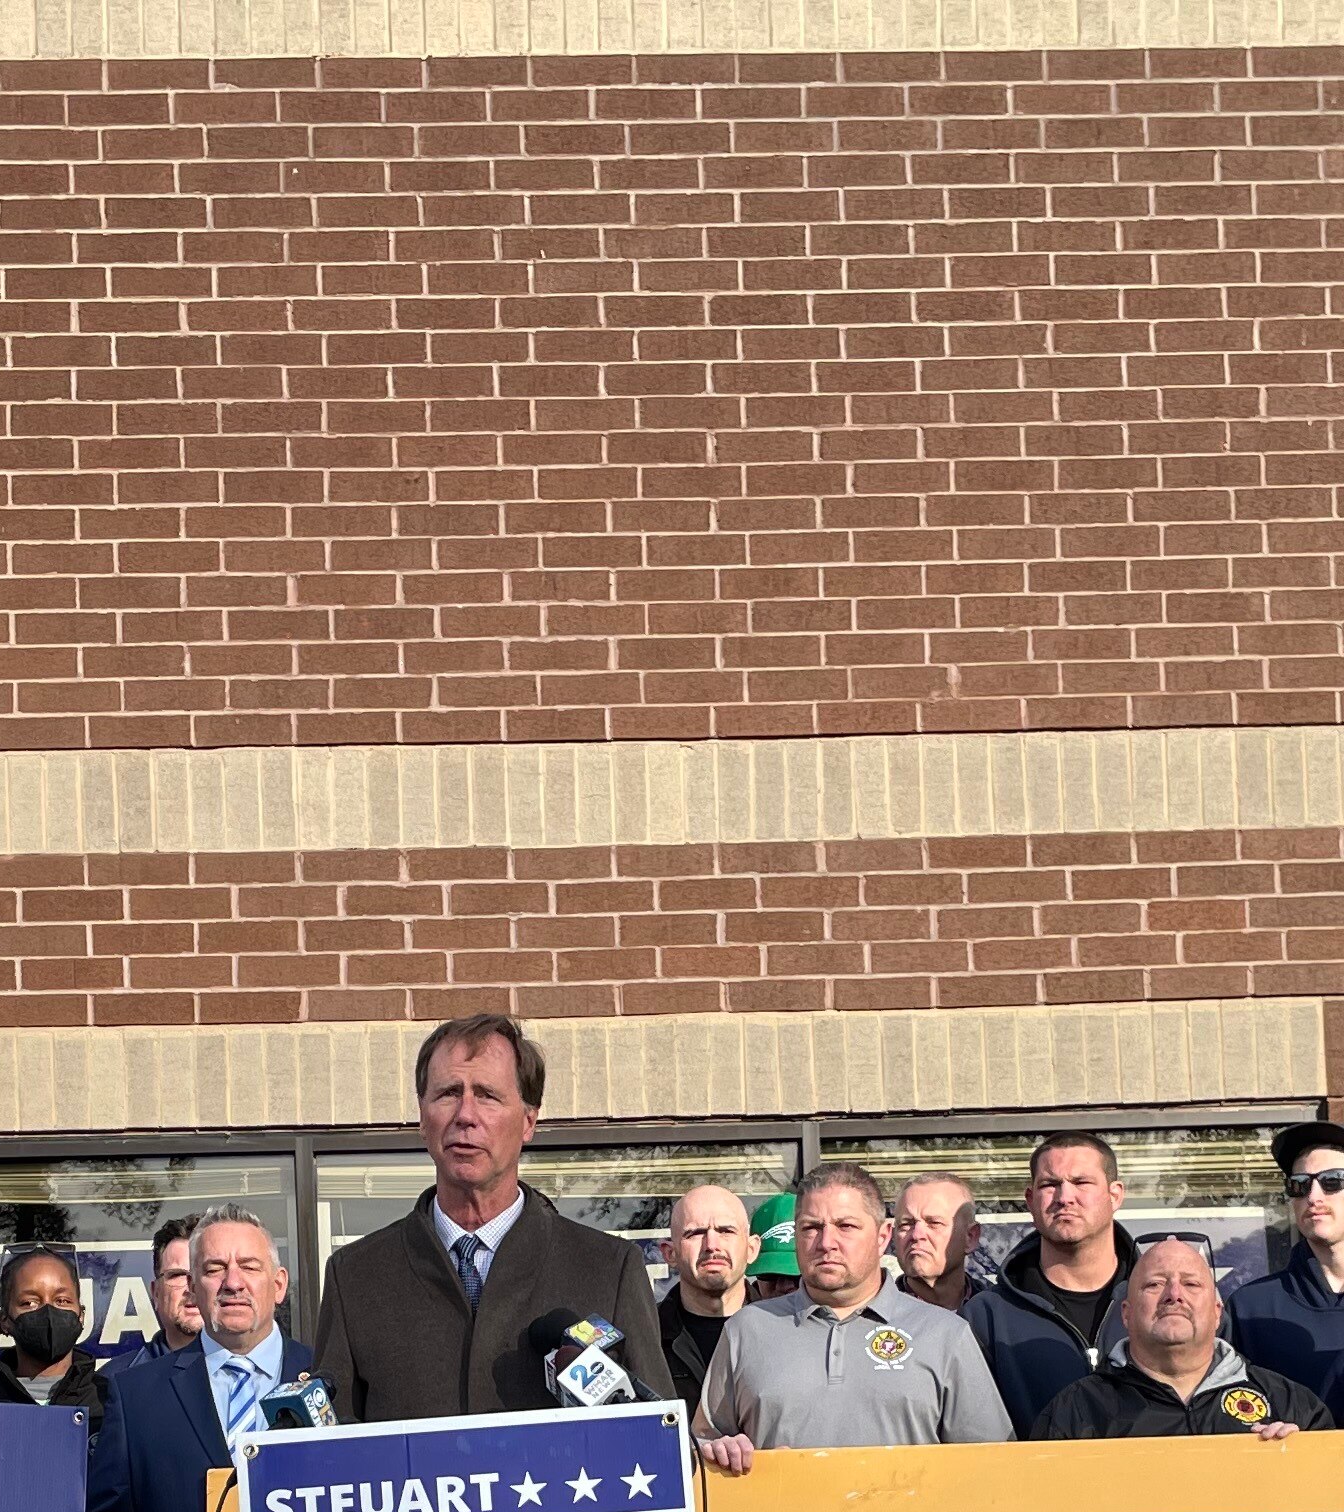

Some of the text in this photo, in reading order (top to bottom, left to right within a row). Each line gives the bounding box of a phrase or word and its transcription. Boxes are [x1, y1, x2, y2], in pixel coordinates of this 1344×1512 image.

[570, 1365, 598, 1390] 2
[584, 1369, 614, 1395] WMAR
[592, 1377, 616, 1398] NEWS
